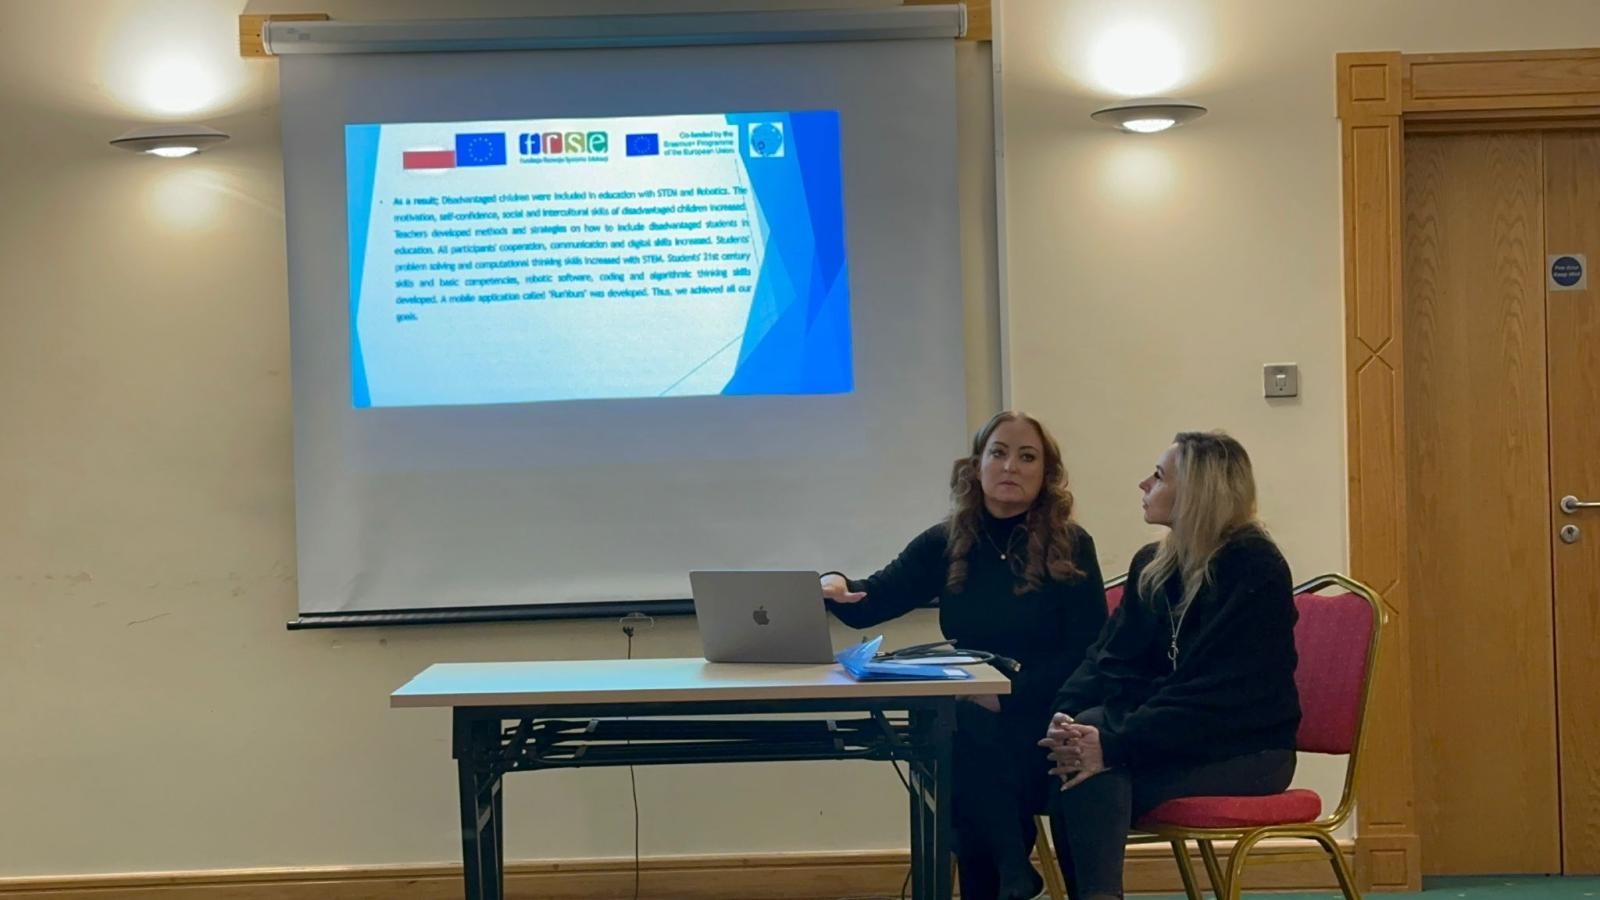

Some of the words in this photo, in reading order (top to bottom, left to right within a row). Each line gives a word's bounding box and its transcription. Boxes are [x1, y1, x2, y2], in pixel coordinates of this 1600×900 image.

[393, 197, 403, 206] As
[442, 194, 497, 205] Disadvantaged
[499, 193, 530, 202] children
[554, 191, 587, 200] included
[598, 190, 636, 199] education
[638, 190, 655, 198] with
[657, 188, 678, 197] STEM
[680, 188, 694, 196] and
[732, 186, 747, 195] The
[394, 213, 437, 223] motivation,
[439, 210, 500, 221] self-confidence,
[502, 209, 523, 219] social
[526, 208, 541, 217] and
[543, 207, 589, 217] intercultural
[591, 206, 609, 216] skills
[611, 206, 620, 215] of
[621, 204, 676, 216] disadvantaged
[677, 203, 707, 213] children
[394, 229, 428, 239] Teachers
[431, 228, 471, 239] developed
[475, 226, 508, 236] methods
[512, 226, 526, 235] and
[530, 224, 567, 235] strategies
[570, 225, 581, 233] on
[584, 223, 600, 232] how
[604, 224, 614, 232] to
[617, 222, 645, 231] include
[649, 220, 702, 231] disadvantaged
[706, 219, 737, 229] students
[742, 218, 750, 227] in
[394, 246, 434, 255] education.
[437, 245, 448, 254] All
[499, 242, 547, 253] cooperation,
[550, 240, 607, 250] communication
[610, 239, 625, 248] and
[628, 237, 651, 249] digital
[654, 237, 672, 246] skills
[395, 262, 427, 273] problem
[430, 261, 456, 271] solving
[458, 260, 473, 270] and
[475, 258, 529, 270] computational
[532, 257, 562, 268] thinking
[564, 255, 583, 265] skills
[585, 254, 621, 264] increased
[623, 254, 641, 264] with
[703, 251, 719, 261] 21st
[721, 251, 751, 262] century
[395, 278, 414, 288] skills
[419, 277, 434, 287] and
[440, 276, 459, 286] basic
[526, 273, 553, 283] robotic
[599, 272, 625, 282] coding
[629, 271, 645, 280] and
[649, 270, 692, 281] algorithmic
[697, 268, 728, 279] thinking
[733, 266, 751, 276] skills
[396, 295, 437, 305] developed.
[449, 293, 476, 303] mobile
[478, 292, 520, 303] application
[522, 291, 546, 300] called
[690, 285, 724, 295] achieved
[726, 285, 736, 293] all
[738, 285, 752, 293] our
[396, 312, 418, 323] goals.
